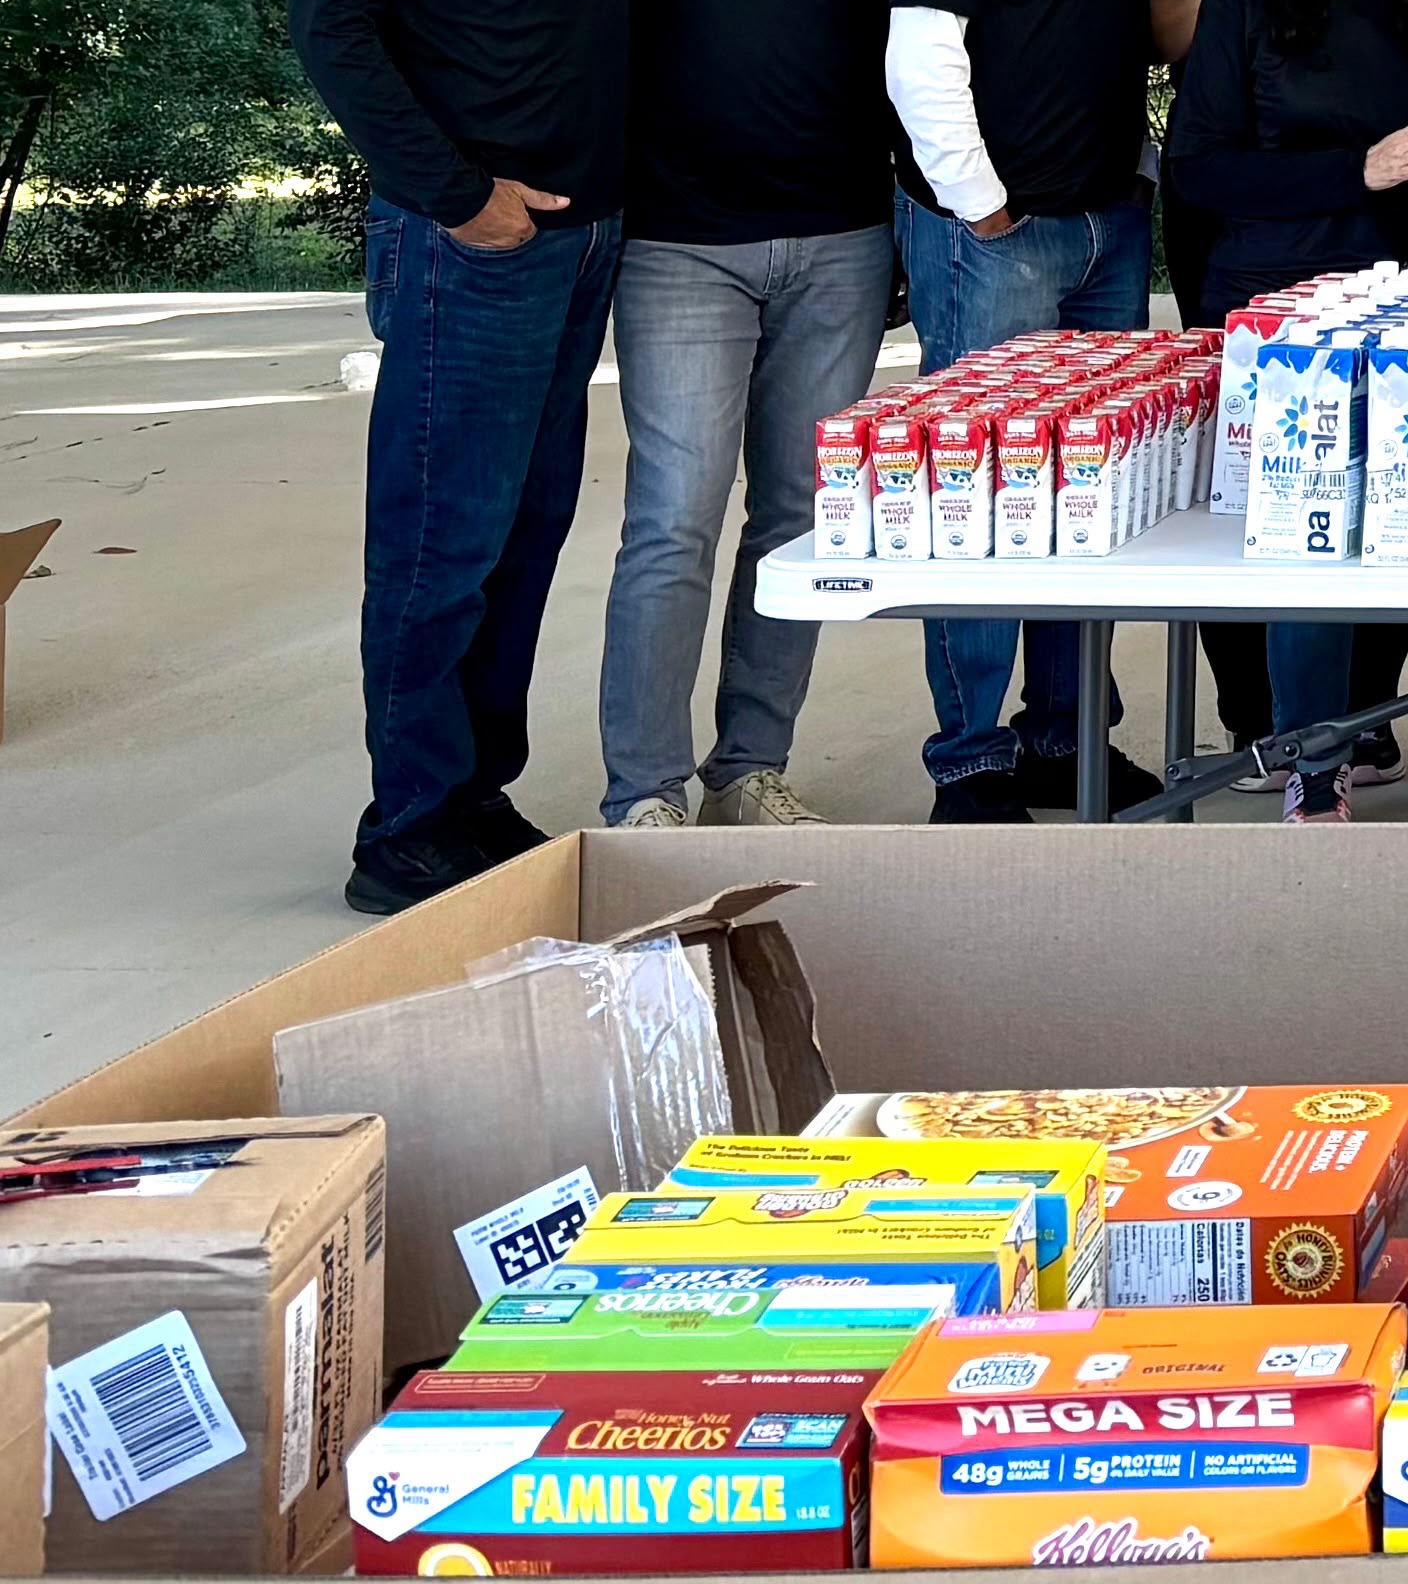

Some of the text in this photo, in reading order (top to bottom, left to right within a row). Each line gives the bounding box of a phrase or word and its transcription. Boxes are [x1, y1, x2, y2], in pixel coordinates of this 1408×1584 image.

[1228, 422, 1252, 440] Mi
[1338, 1130, 1368, 1163] PROTEIN
[1297, 1234, 1332, 1255] HONEY
[652, 1268, 767, 1284] FLAKES
[1275, 1251, 1293, 1283] OATS
[1197, 1278, 1210, 1301] 250
[594, 1292, 759, 1316] Cheerios
[315, 1233, 337, 1491] parmalat
[1141, 1363, 1225, 1376] ORIGINAL
[750, 1374, 793, 1384] Whole
[637, 1412, 732, 1425] Honey Nut
[957, 1392, 1295, 1437] MEGA SIZE
[567, 1418, 732, 1451] Cheerios
[1073, 1456, 1110, 1484] 5g
[1111, 1454, 1181, 1469] PROTEIN
[1204, 1453, 1297, 1466] NO ARTIFICIAL
[952, 1459, 1049, 1485] 48g WHOLE GRAINS
[402, 1484, 449, 1494] General
[511, 1474, 788, 1524] FAMILY SIZE
[402, 1497, 429, 1506] Mills
